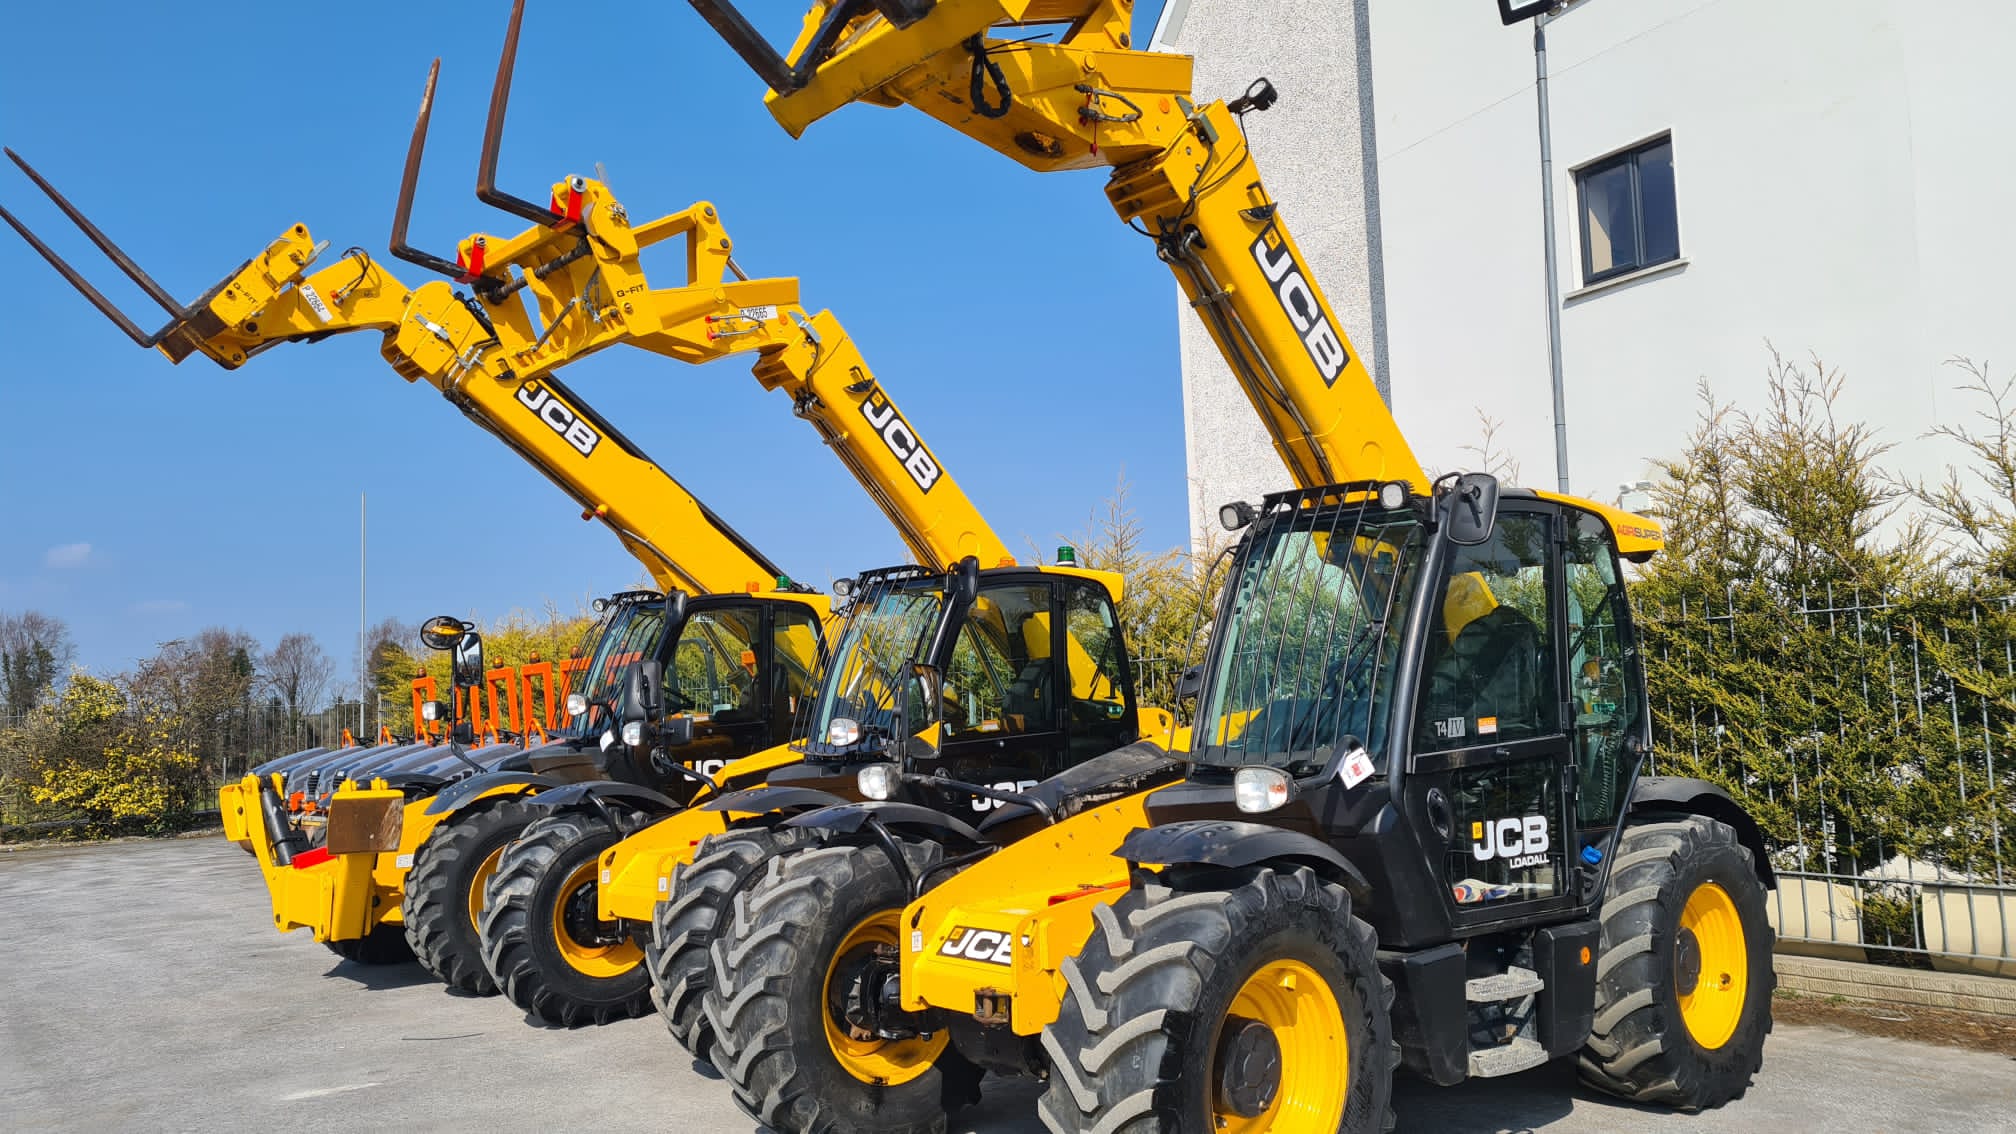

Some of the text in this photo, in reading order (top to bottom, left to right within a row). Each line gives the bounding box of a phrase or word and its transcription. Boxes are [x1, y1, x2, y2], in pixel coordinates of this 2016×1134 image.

[1255, 239, 1345, 380] JCB
[518, 387, 598, 454] JCB
[863, 400, 938, 489] JCB
[683, 760, 740, 781] JC
[1473, 815, 1549, 861] JCB
[1510, 853, 1549, 869] LOADALL
